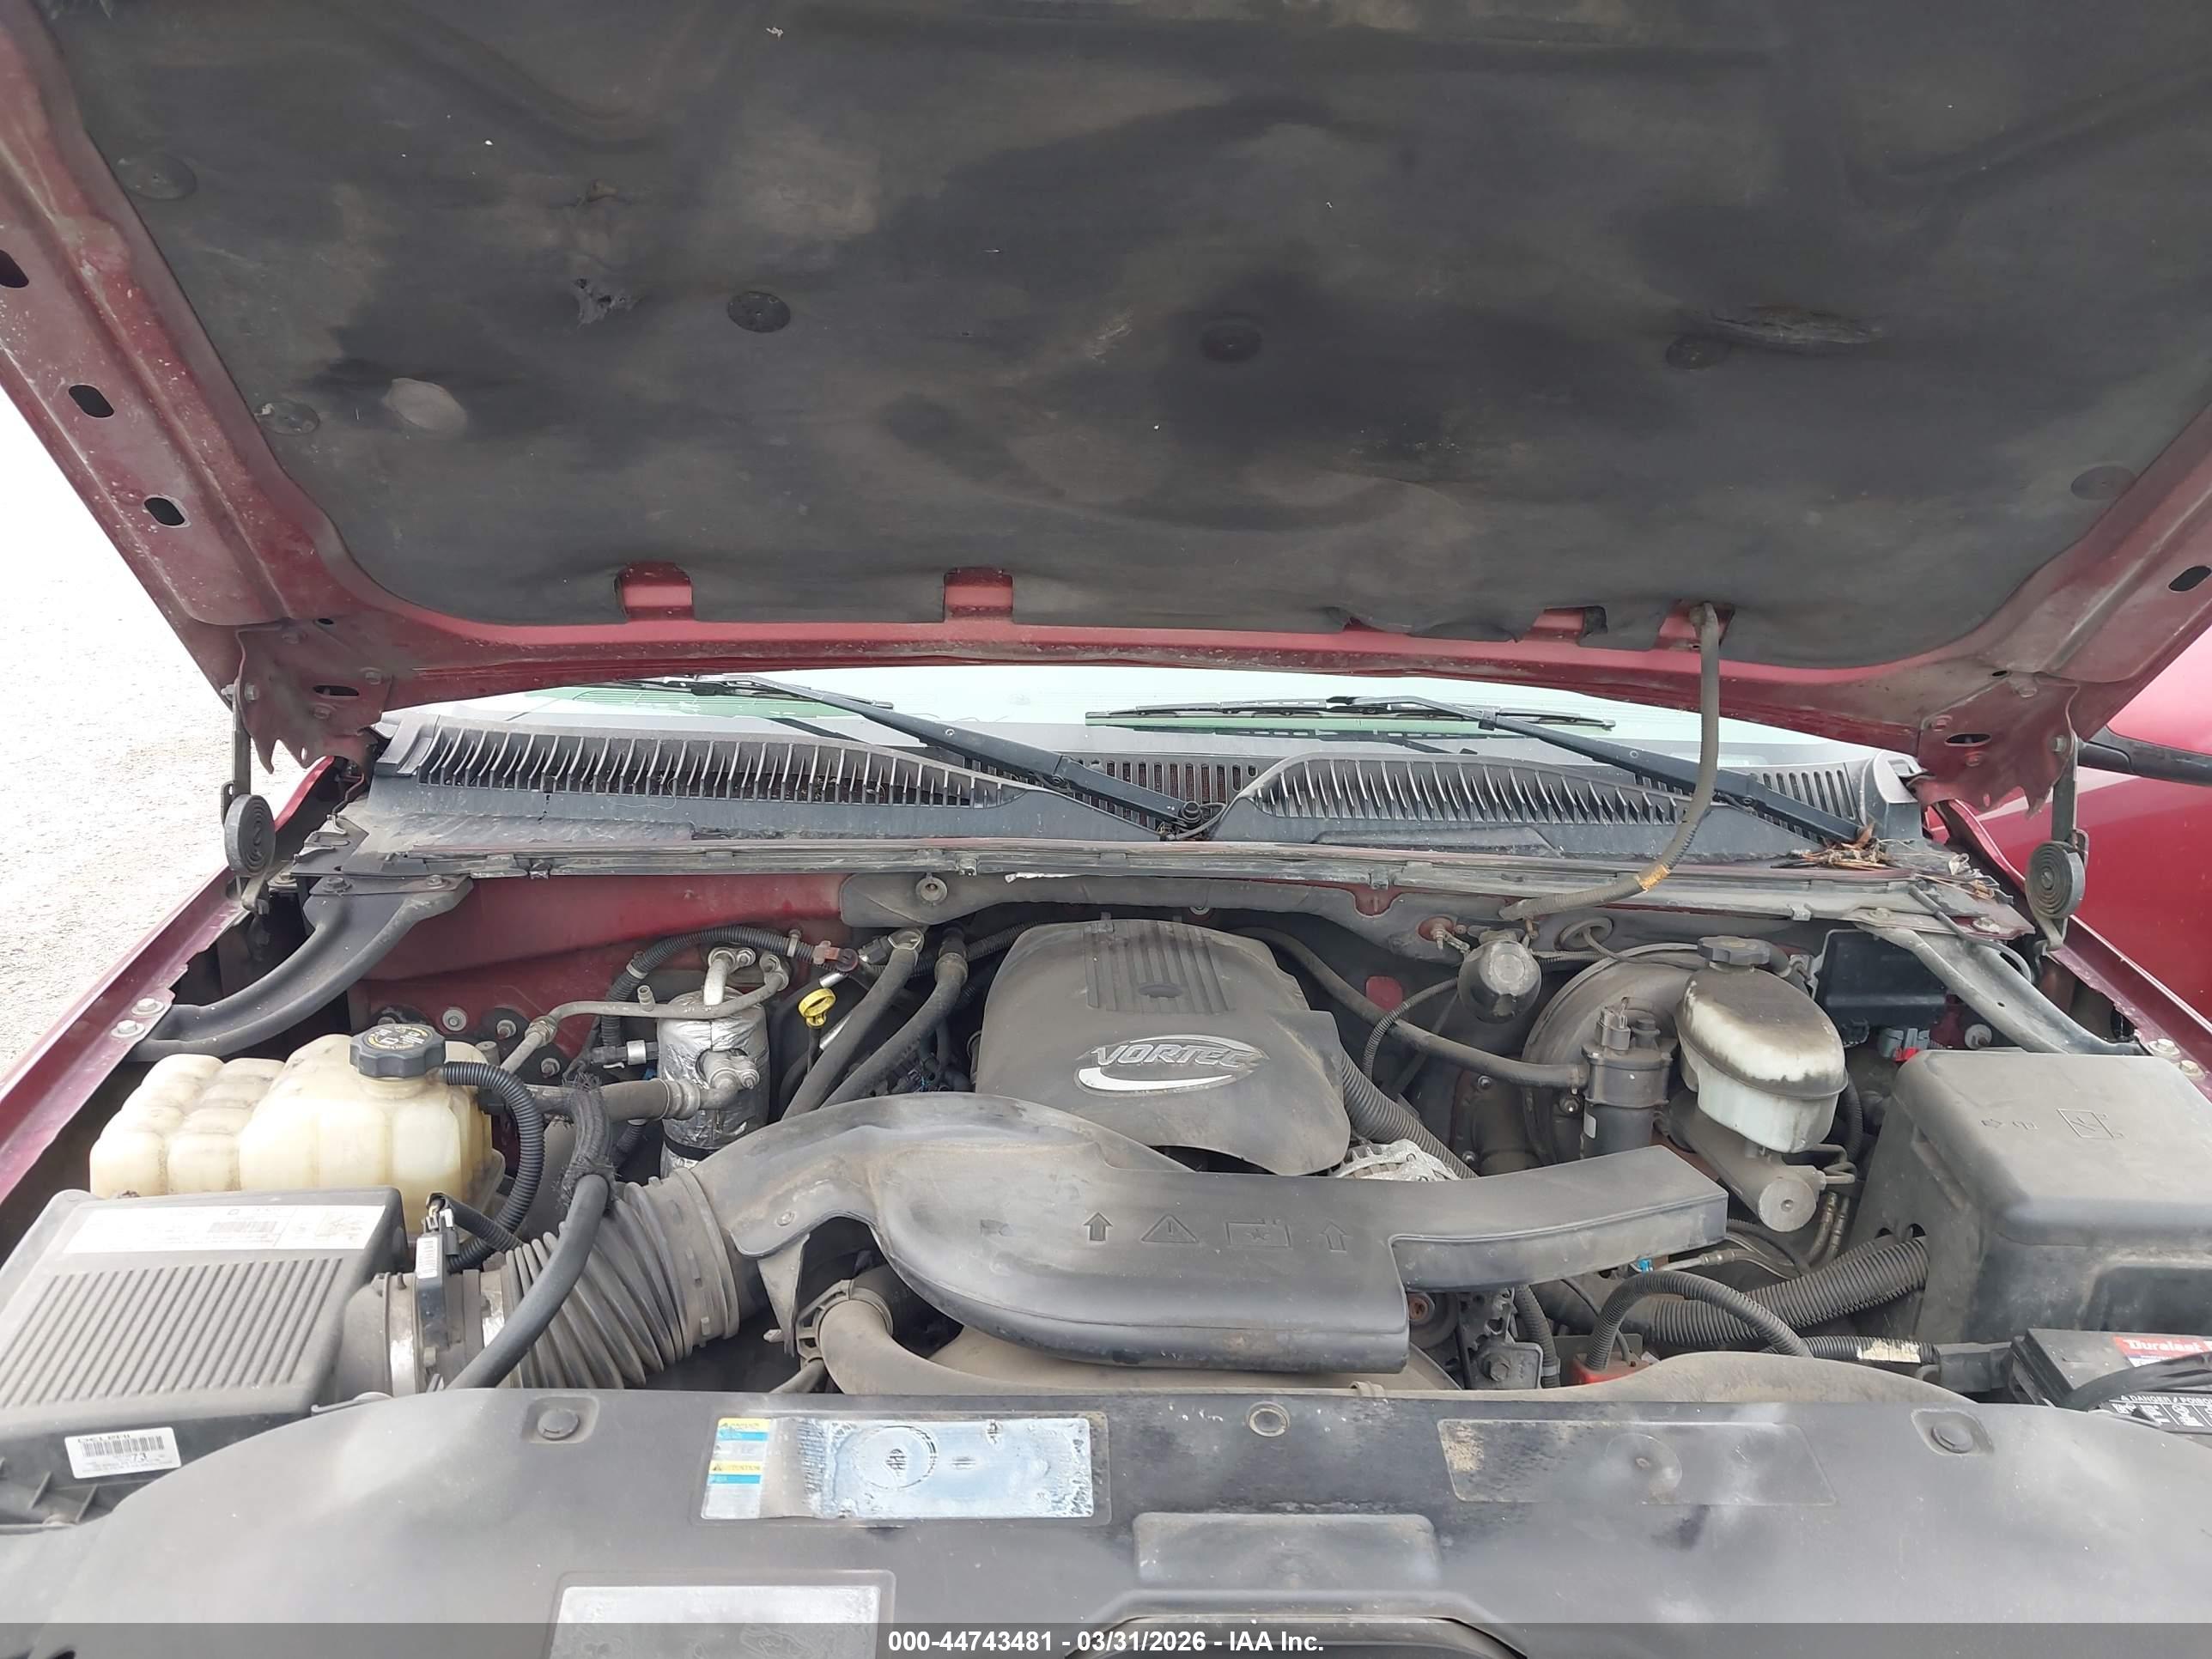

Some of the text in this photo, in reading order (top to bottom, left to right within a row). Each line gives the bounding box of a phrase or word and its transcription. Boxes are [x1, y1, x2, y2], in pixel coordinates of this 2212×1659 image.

[1091, 1042, 1251, 1068] VORTEC
[2122, 1339, 2204, 1353] Duralast
[2130, 1395, 2172, 1404] DANGER
